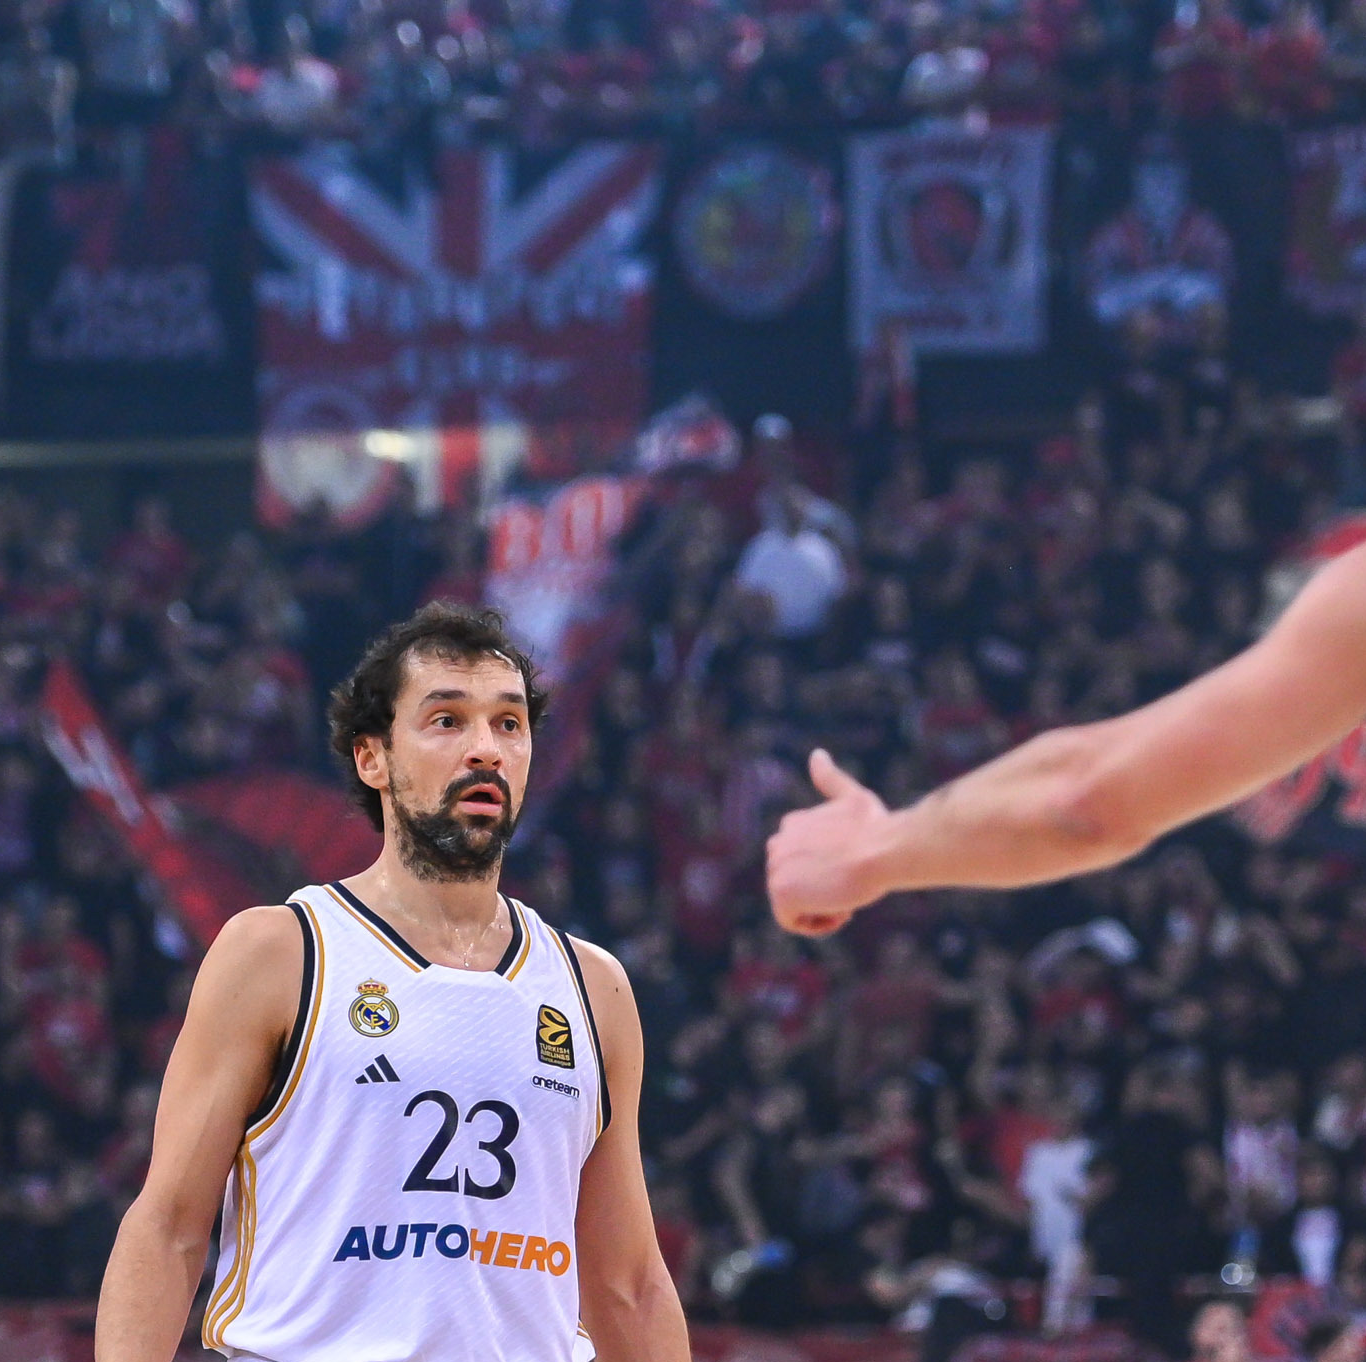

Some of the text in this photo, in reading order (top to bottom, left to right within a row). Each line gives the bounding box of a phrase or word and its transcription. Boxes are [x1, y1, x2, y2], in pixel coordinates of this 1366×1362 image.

[532, 1075, 580, 1098] oneteam
[401, 1090, 521, 1201] 23
[333, 1223, 572, 1277] AUTOHERO
